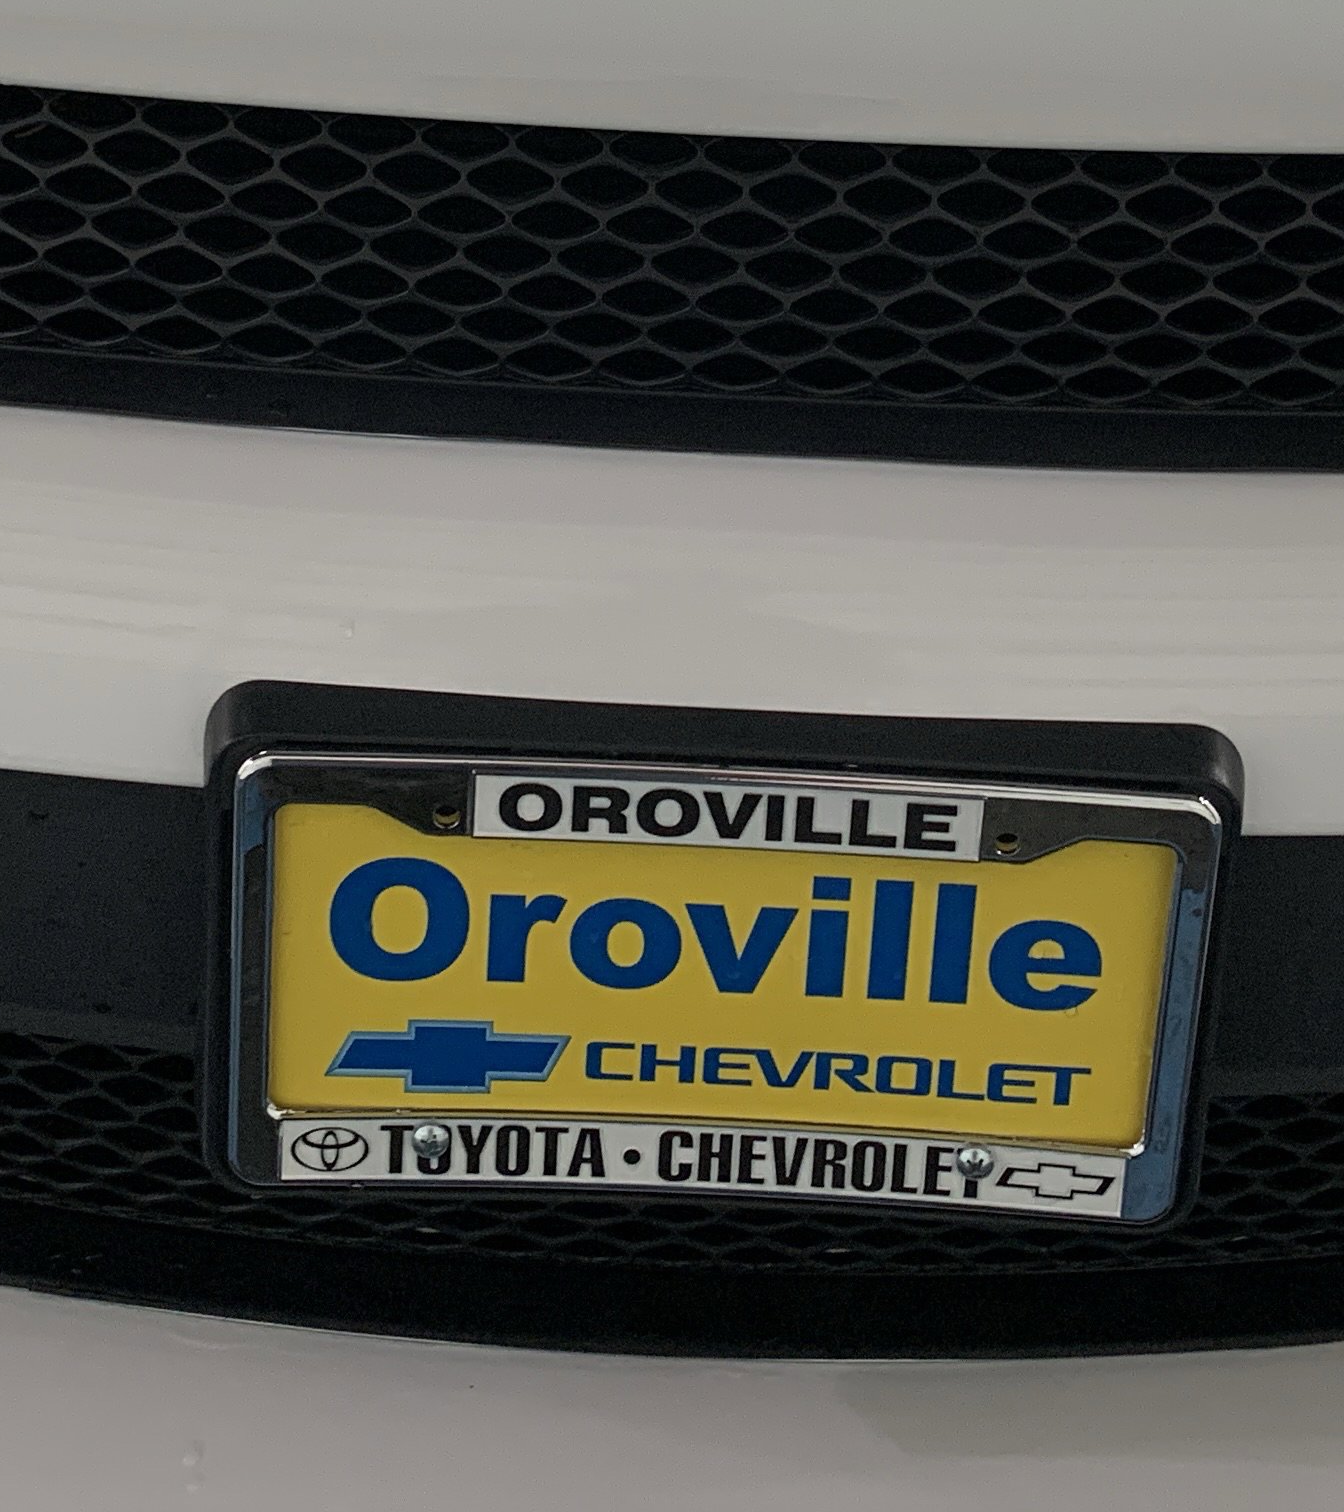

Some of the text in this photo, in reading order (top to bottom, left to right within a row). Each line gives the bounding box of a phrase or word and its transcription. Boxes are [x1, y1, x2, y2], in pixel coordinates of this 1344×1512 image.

[498, 783, 957, 851] OROVILLE
[329, 856, 1103, 1012] Oroville
[585, 1040, 1092, 1106] CHEVROLET
